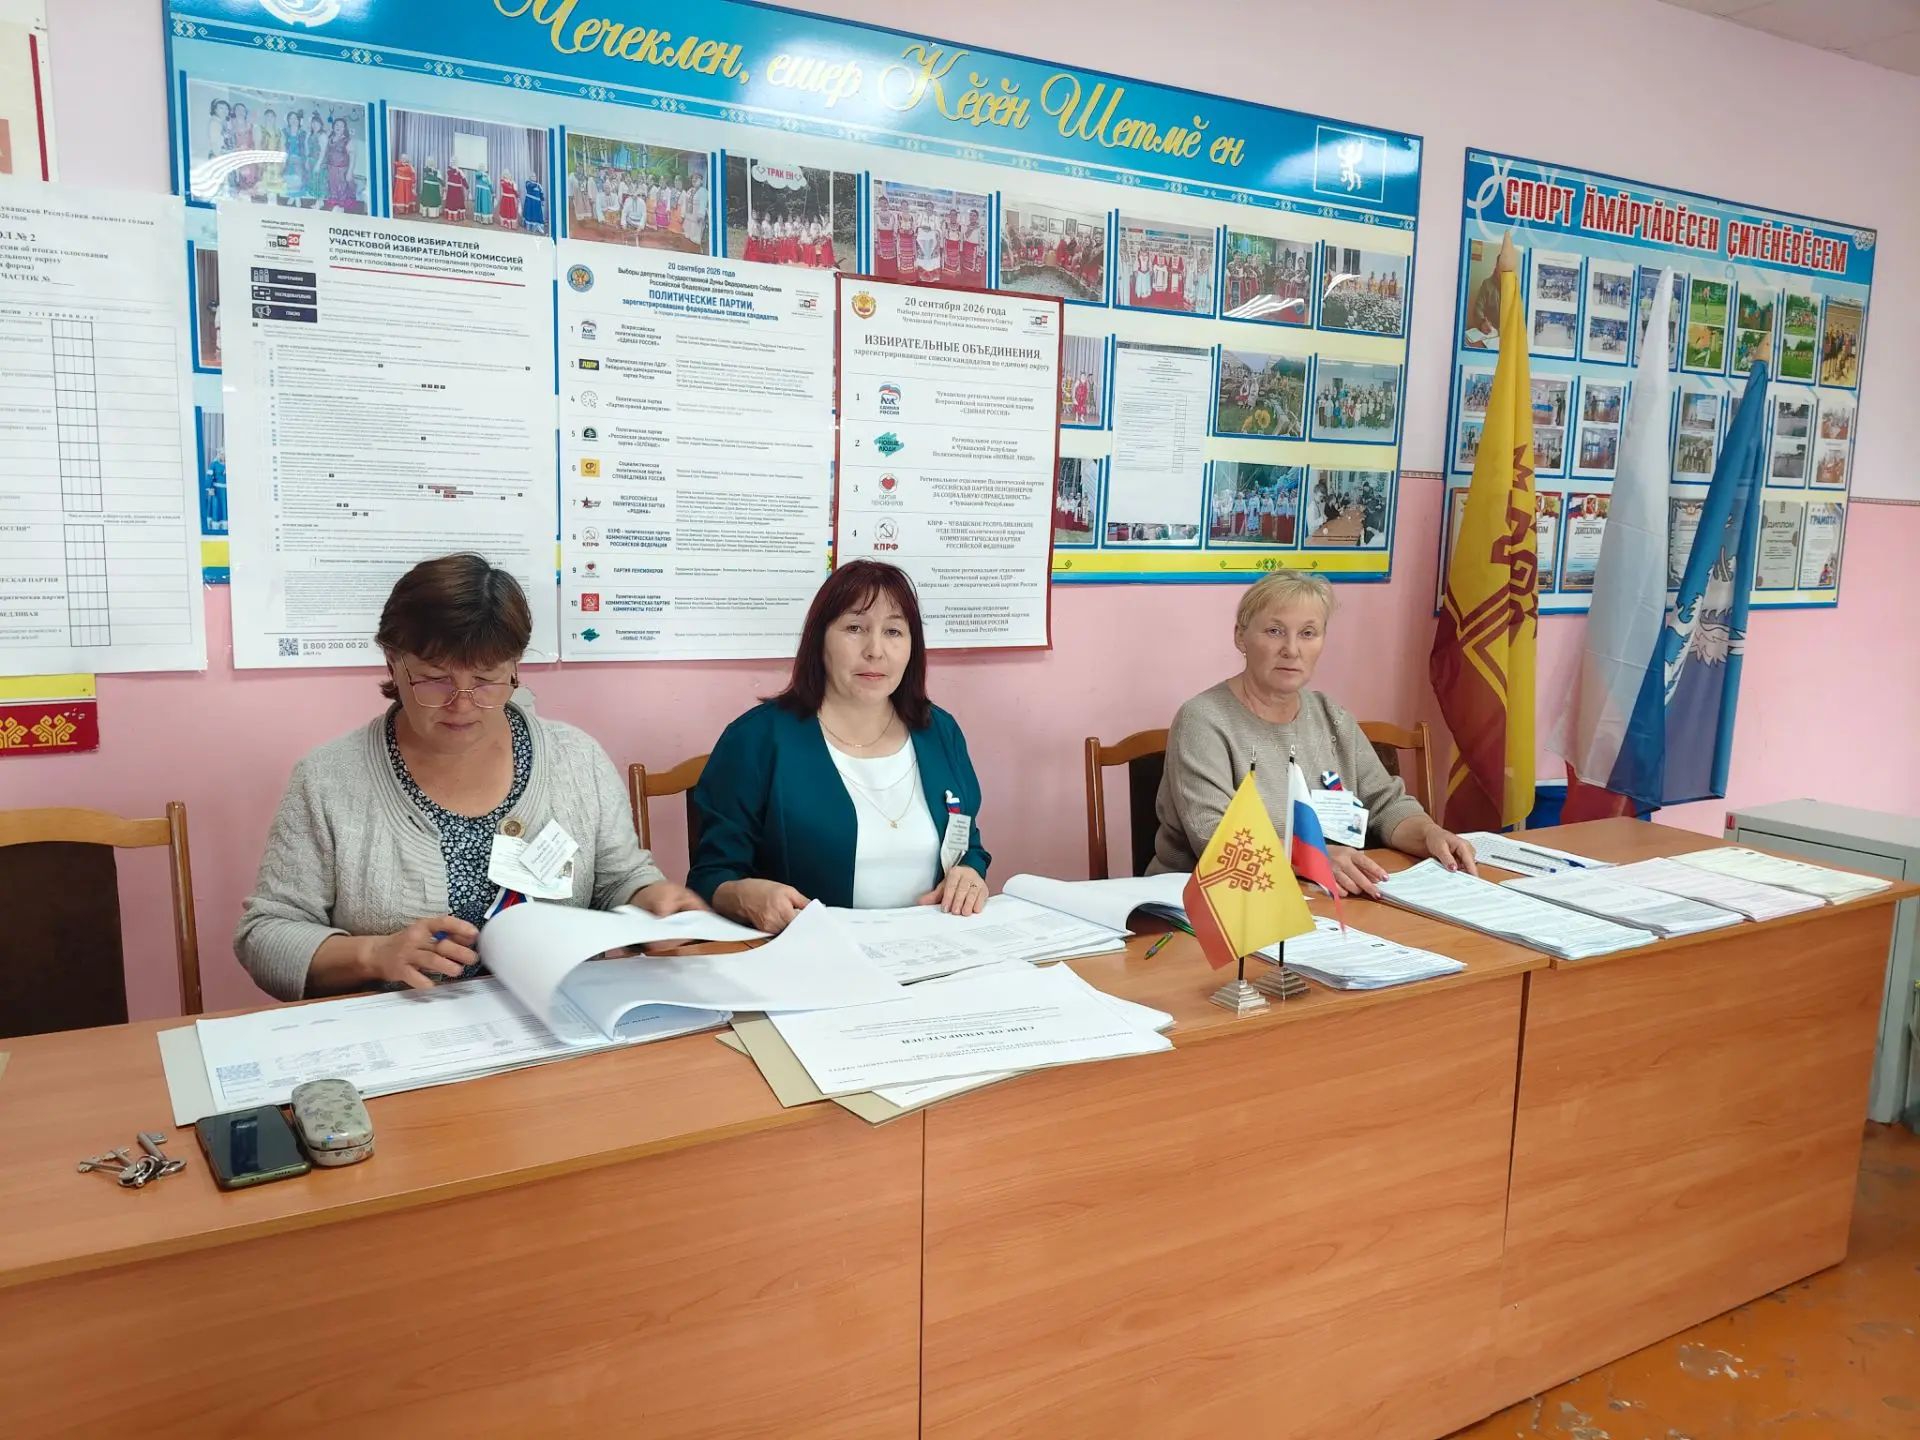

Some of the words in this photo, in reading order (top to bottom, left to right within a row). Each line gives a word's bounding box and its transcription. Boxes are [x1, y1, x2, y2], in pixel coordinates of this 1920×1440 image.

[1209, 136, 1245, 166] ен
[1505, 179, 1574, 225] СПОРТ
[30, 234, 36, 242] 2
[329, 227, 371, 238] ПОДСЧЕТ
[373, 232, 416, 243] ГОЛОСОВ
[417, 237, 480, 250] ИЗБИРАТЕЛЕЙ
[268, 240, 277, 248] 18
[329, 237, 391, 250] УЧАСТКОВОЙ
[392, 244, 468, 259] ИЗБИРАТЕЛЬНОЙ
[470, 253, 523, 264] КОМИССИЕЙ
[618, 266, 640, 276] Выборы
[668, 261, 676, 270] 20
[677, 264, 705, 274] сентября
[706, 267, 721, 276] 2026
[722, 270, 736, 278] года
[649, 279, 681, 289] Российской
[649, 289, 718, 307] ПОЛИТИЧЕСКИЕ
[719, 297, 755, 312] ПАРТИИ,
[904, 296, 916, 306] 20
[918, 300, 961, 312] сентября
[963, 303, 985, 313] 2026
[986, 307, 1006, 316] года
[864, 334, 960, 353] ИЗБИРАТЕЛЬНЫЕ
[854, 348, 927, 360] зарегистрировавшие
[856, 393, 860, 401] 1
[854, 439, 860, 447] 2
[853, 485, 858, 493] 3
[851, 529, 857, 537] 4
[873, 543, 899, 551] КПРФ
[310, 642, 326, 650] 800
[345, 641, 357, 649] 00
[358, 641, 369, 649] 20
